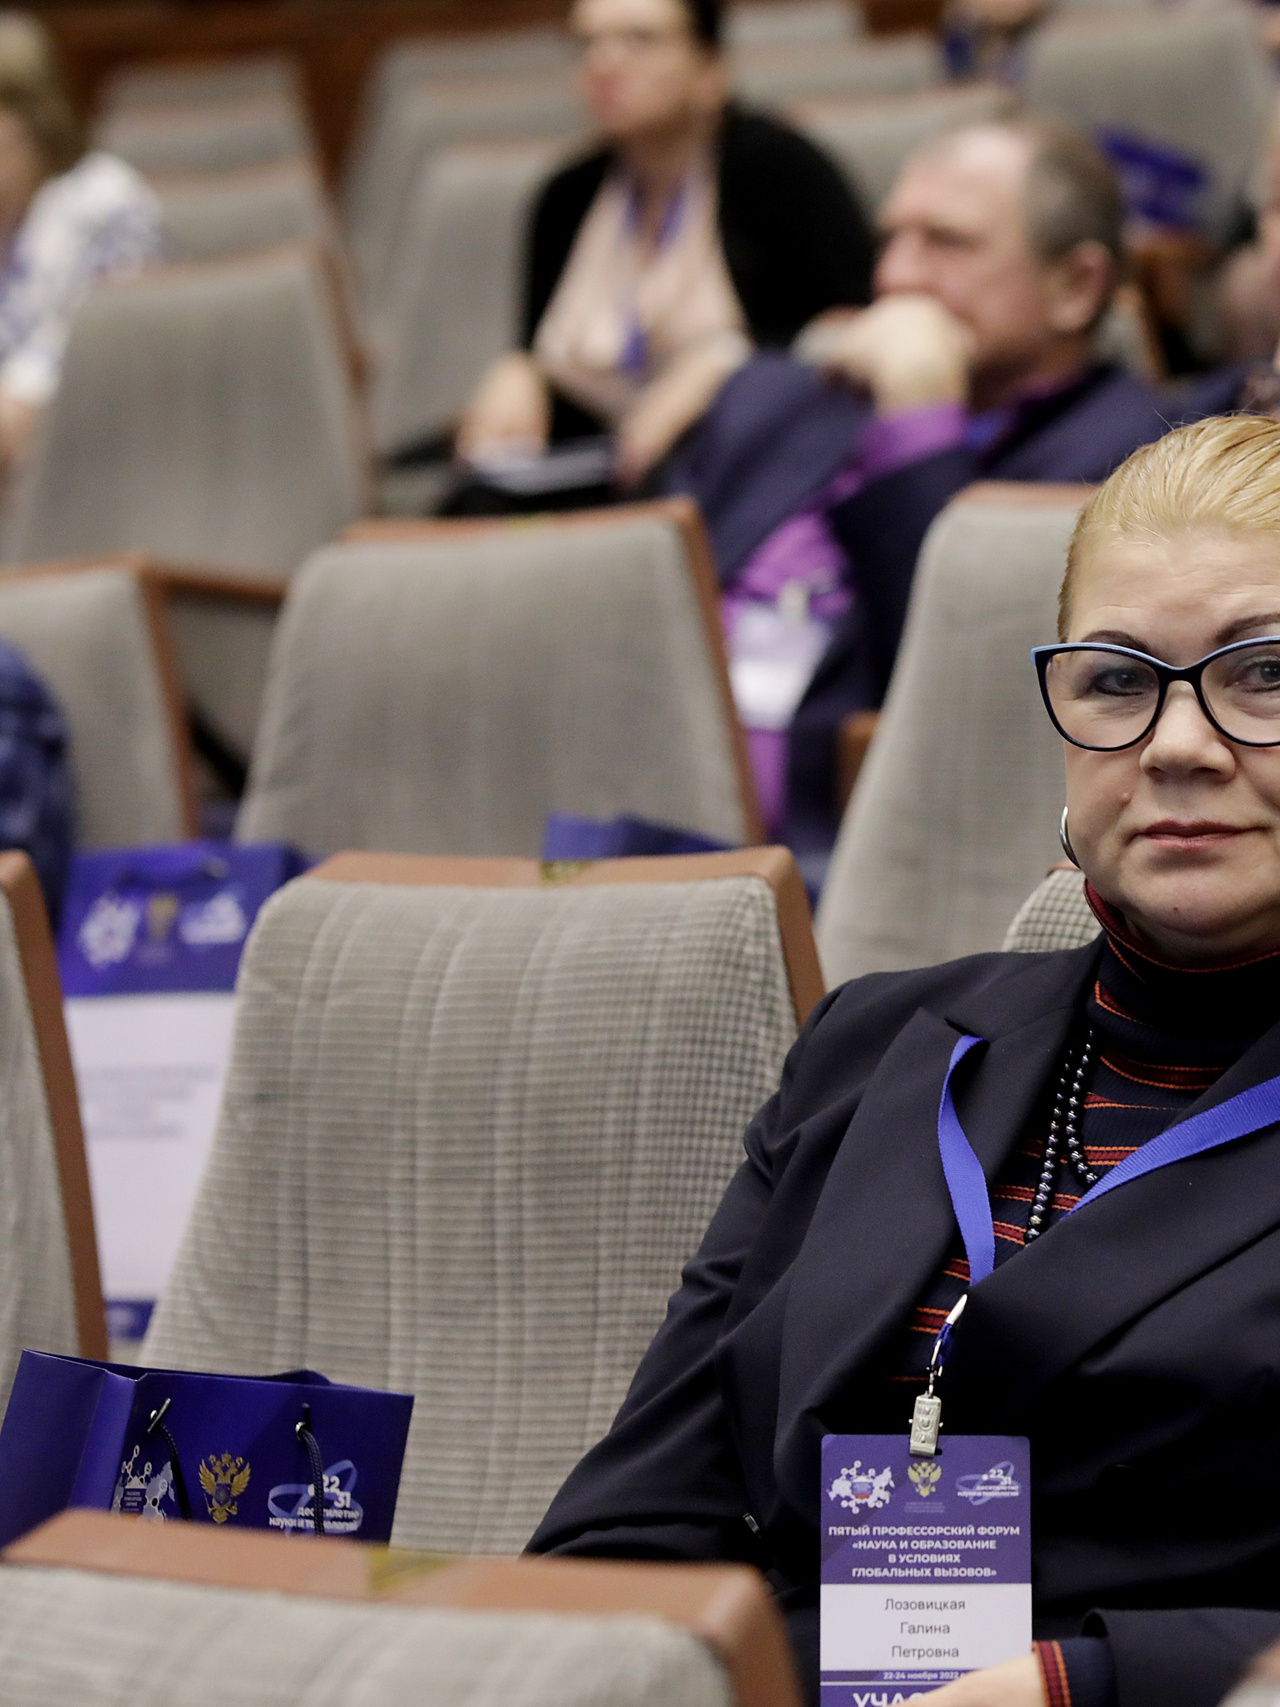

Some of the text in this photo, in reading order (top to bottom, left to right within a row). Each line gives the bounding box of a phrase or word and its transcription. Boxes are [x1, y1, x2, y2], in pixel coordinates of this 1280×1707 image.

[828, 1525, 1020, 1536] ПЯТЫЙ ПРОФЕССОРСКИЙ ФОРУМ
[852, 1540, 997, 1550] «НАУКА И ОБРАЗОВАНИЕ
[888, 1554, 961, 1564] В УСЛОВИЯХ
[852, 1567, 997, 1577] ГЛОБАЛЬНЫХ ВЫЗОВОВ»
[884, 1598, 966, 1612] Лозовицкая
[900, 1621, 951, 1635] Галина
[891, 1645, 960, 1660] Петровна
